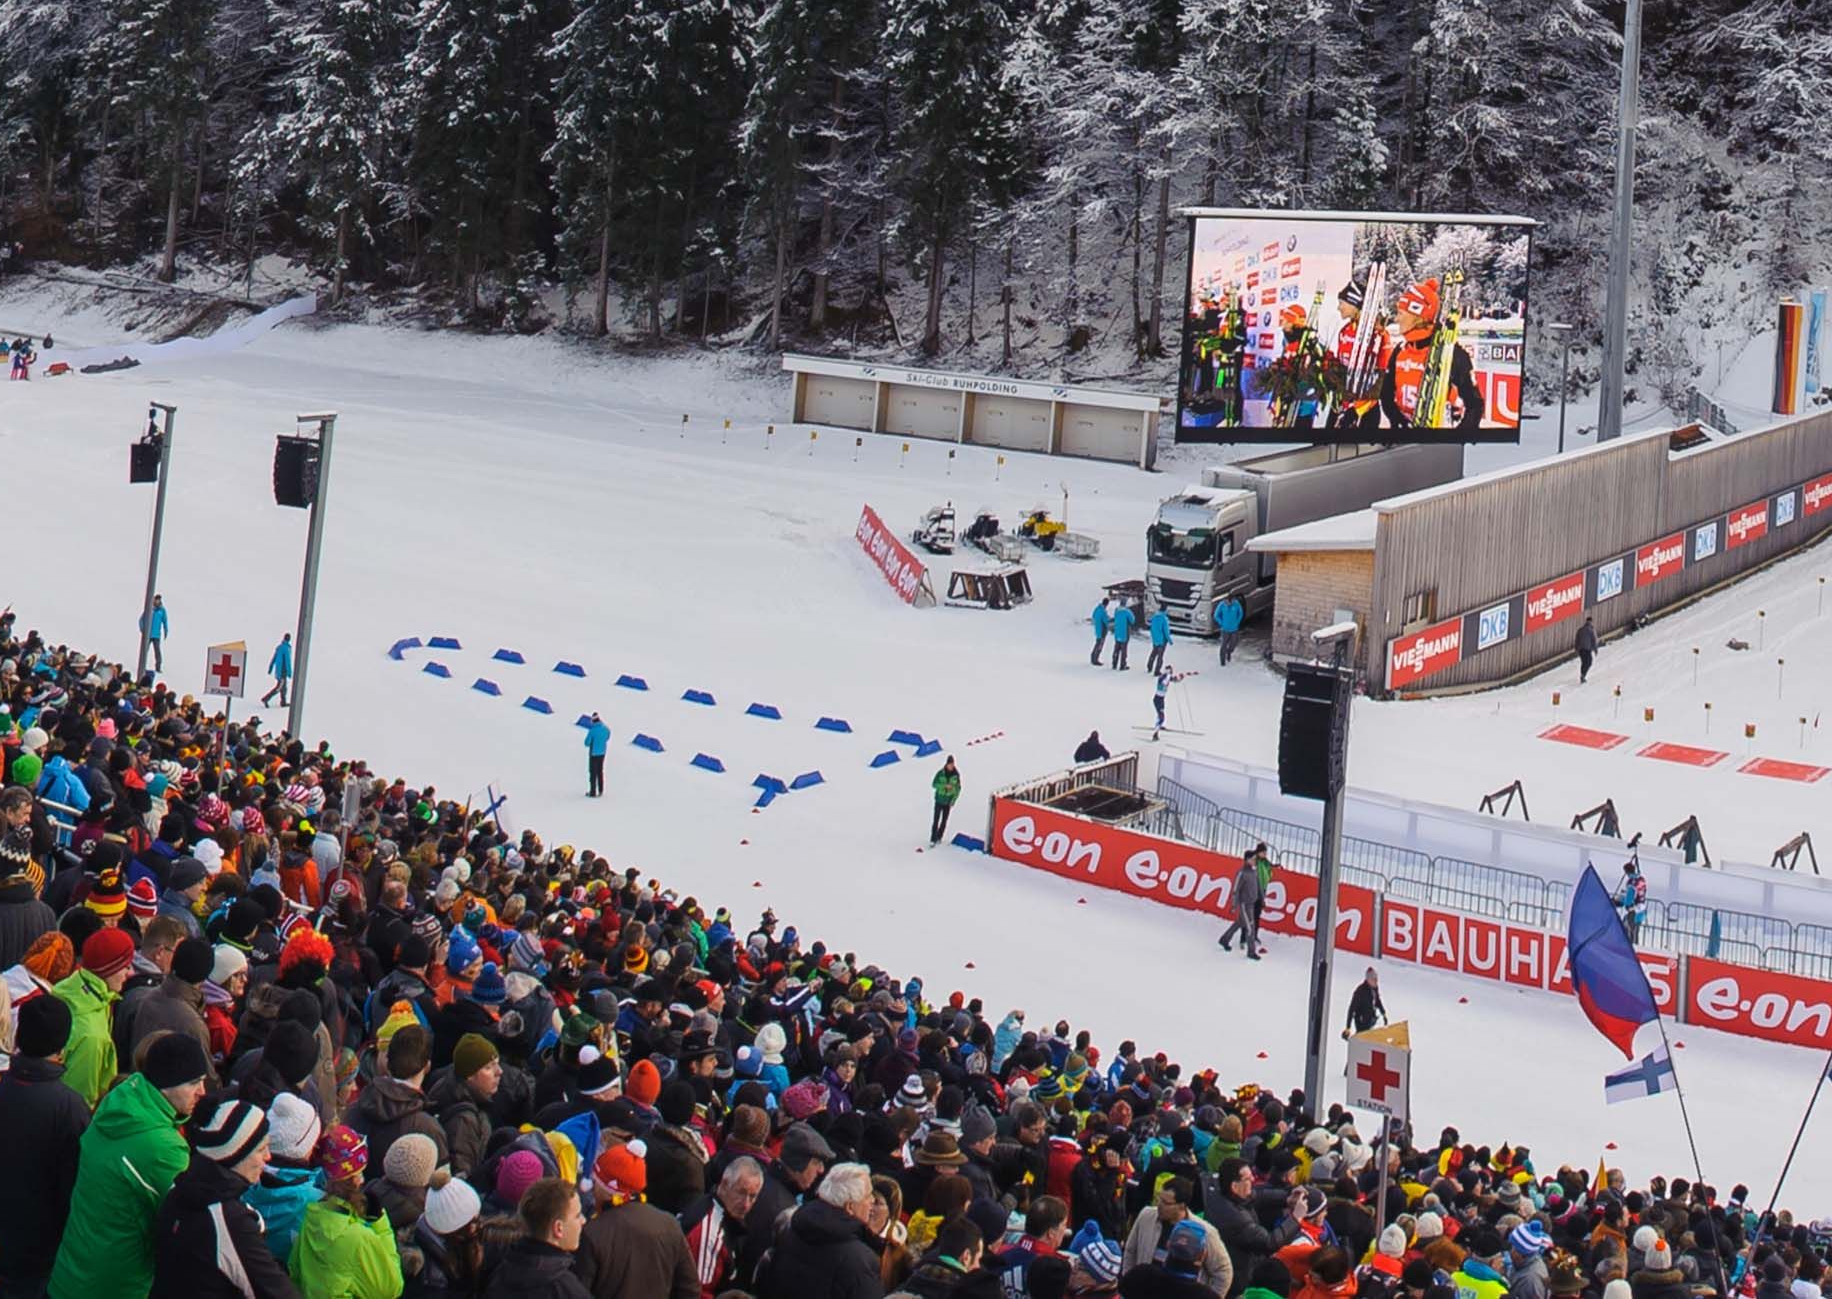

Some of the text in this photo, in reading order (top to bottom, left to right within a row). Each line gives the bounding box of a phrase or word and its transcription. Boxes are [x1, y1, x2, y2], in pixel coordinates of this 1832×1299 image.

[1600, 566, 1622, 595] DKB
[1528, 584, 1582, 620] VIESSMANN
[1480, 610, 1508, 643] DKB
[1394, 631, 1458, 672] VIESSMANN
[1386, 911, 1671, 1006] BAUHAS
